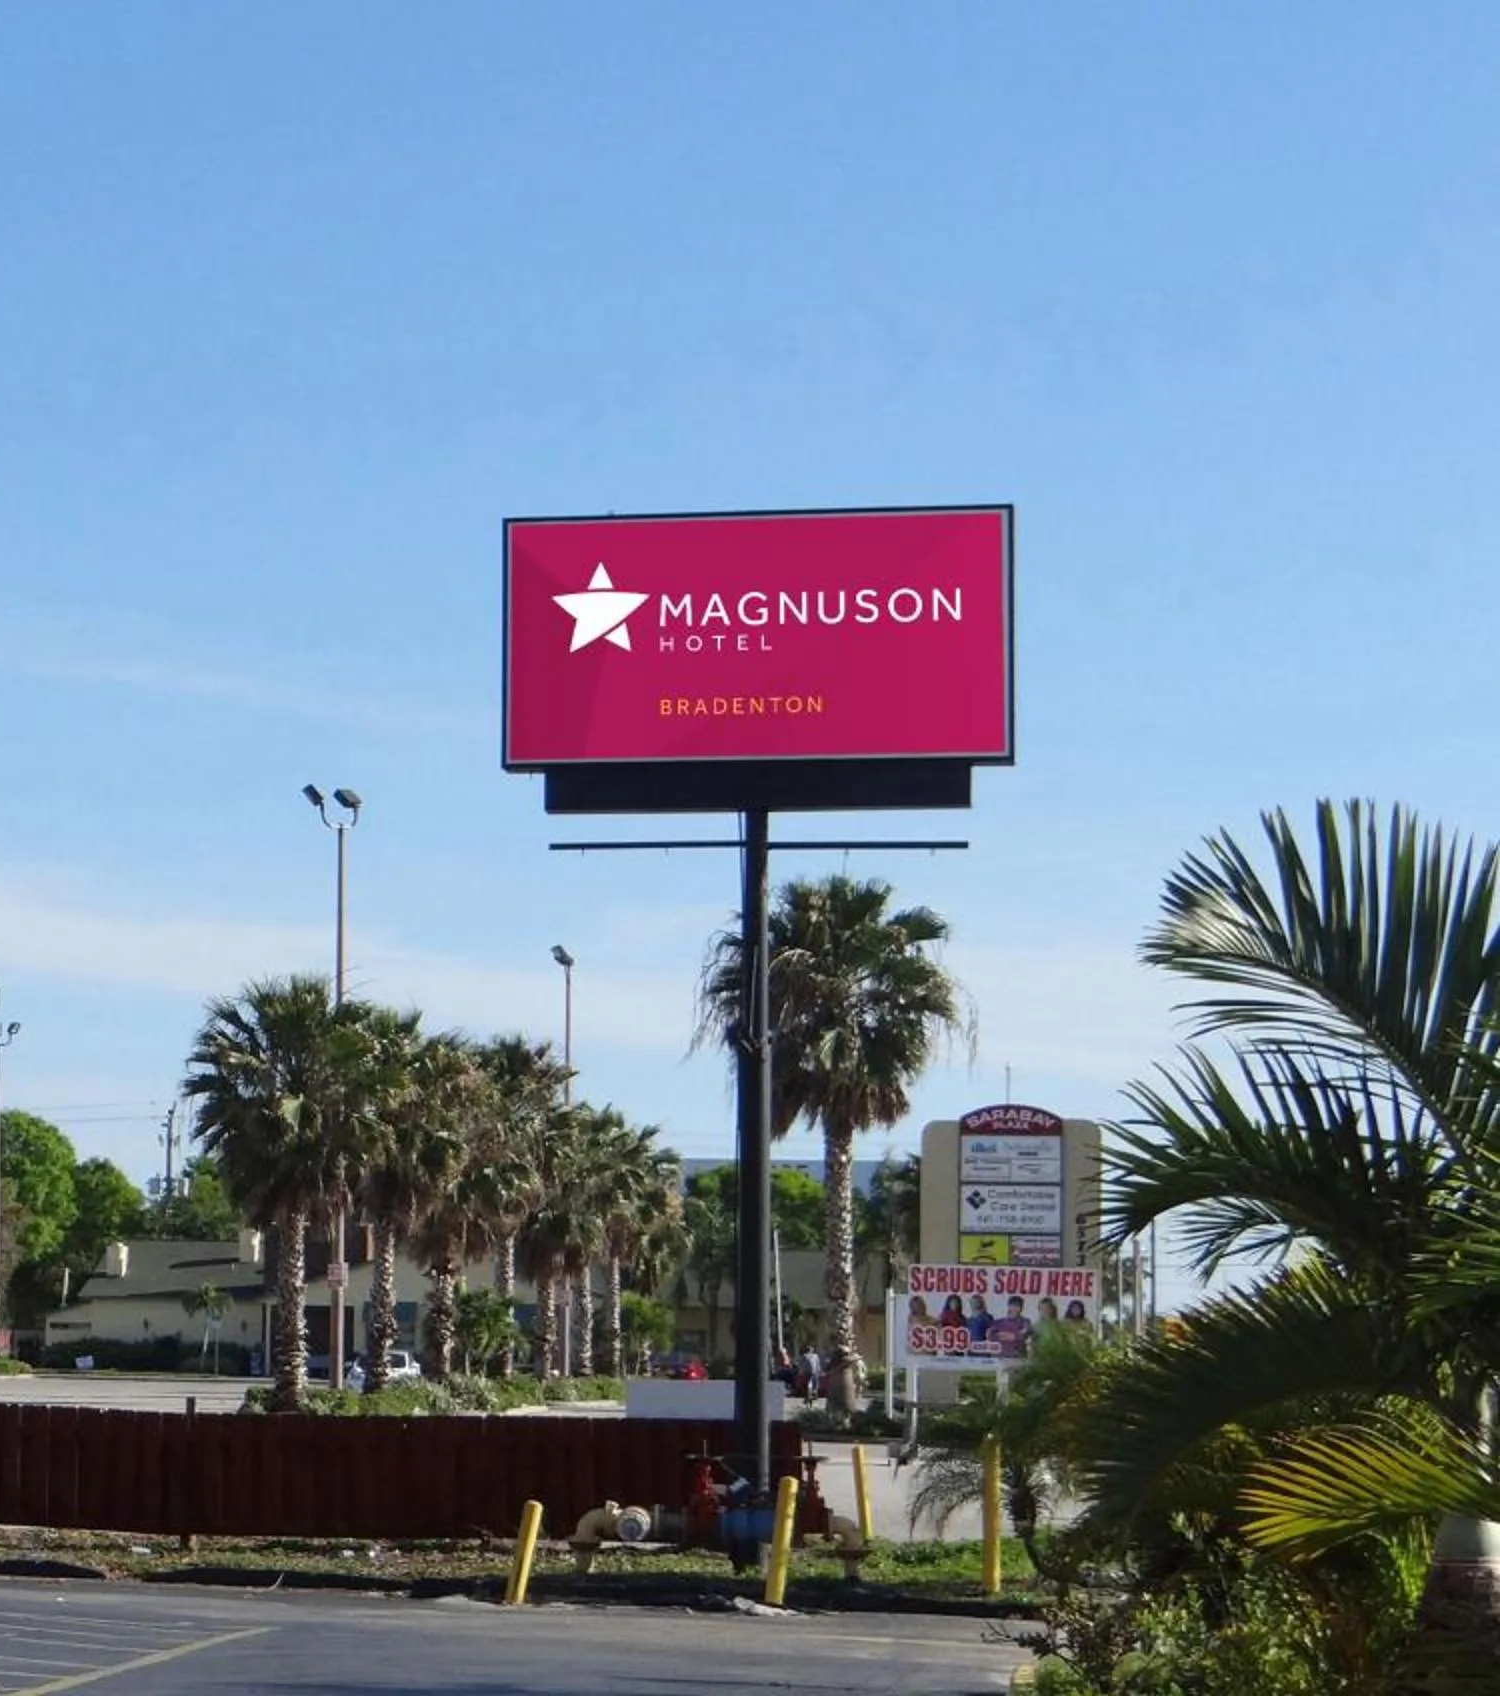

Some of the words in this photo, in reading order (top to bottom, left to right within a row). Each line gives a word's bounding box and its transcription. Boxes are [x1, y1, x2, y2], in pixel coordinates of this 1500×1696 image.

[658, 587, 962, 628] MAGNUSON
[659, 634, 772, 653] HOTEL
[659, 695, 824, 716] BRADENTON
[966, 1109, 1056, 1128] SARABAY
[910, 1266, 988, 1293] SCRUBS
[994, 1268, 1042, 1295] SOLD
[1046, 1271, 1095, 1297] HERE
[911, 1326, 969, 1350] $3.99
